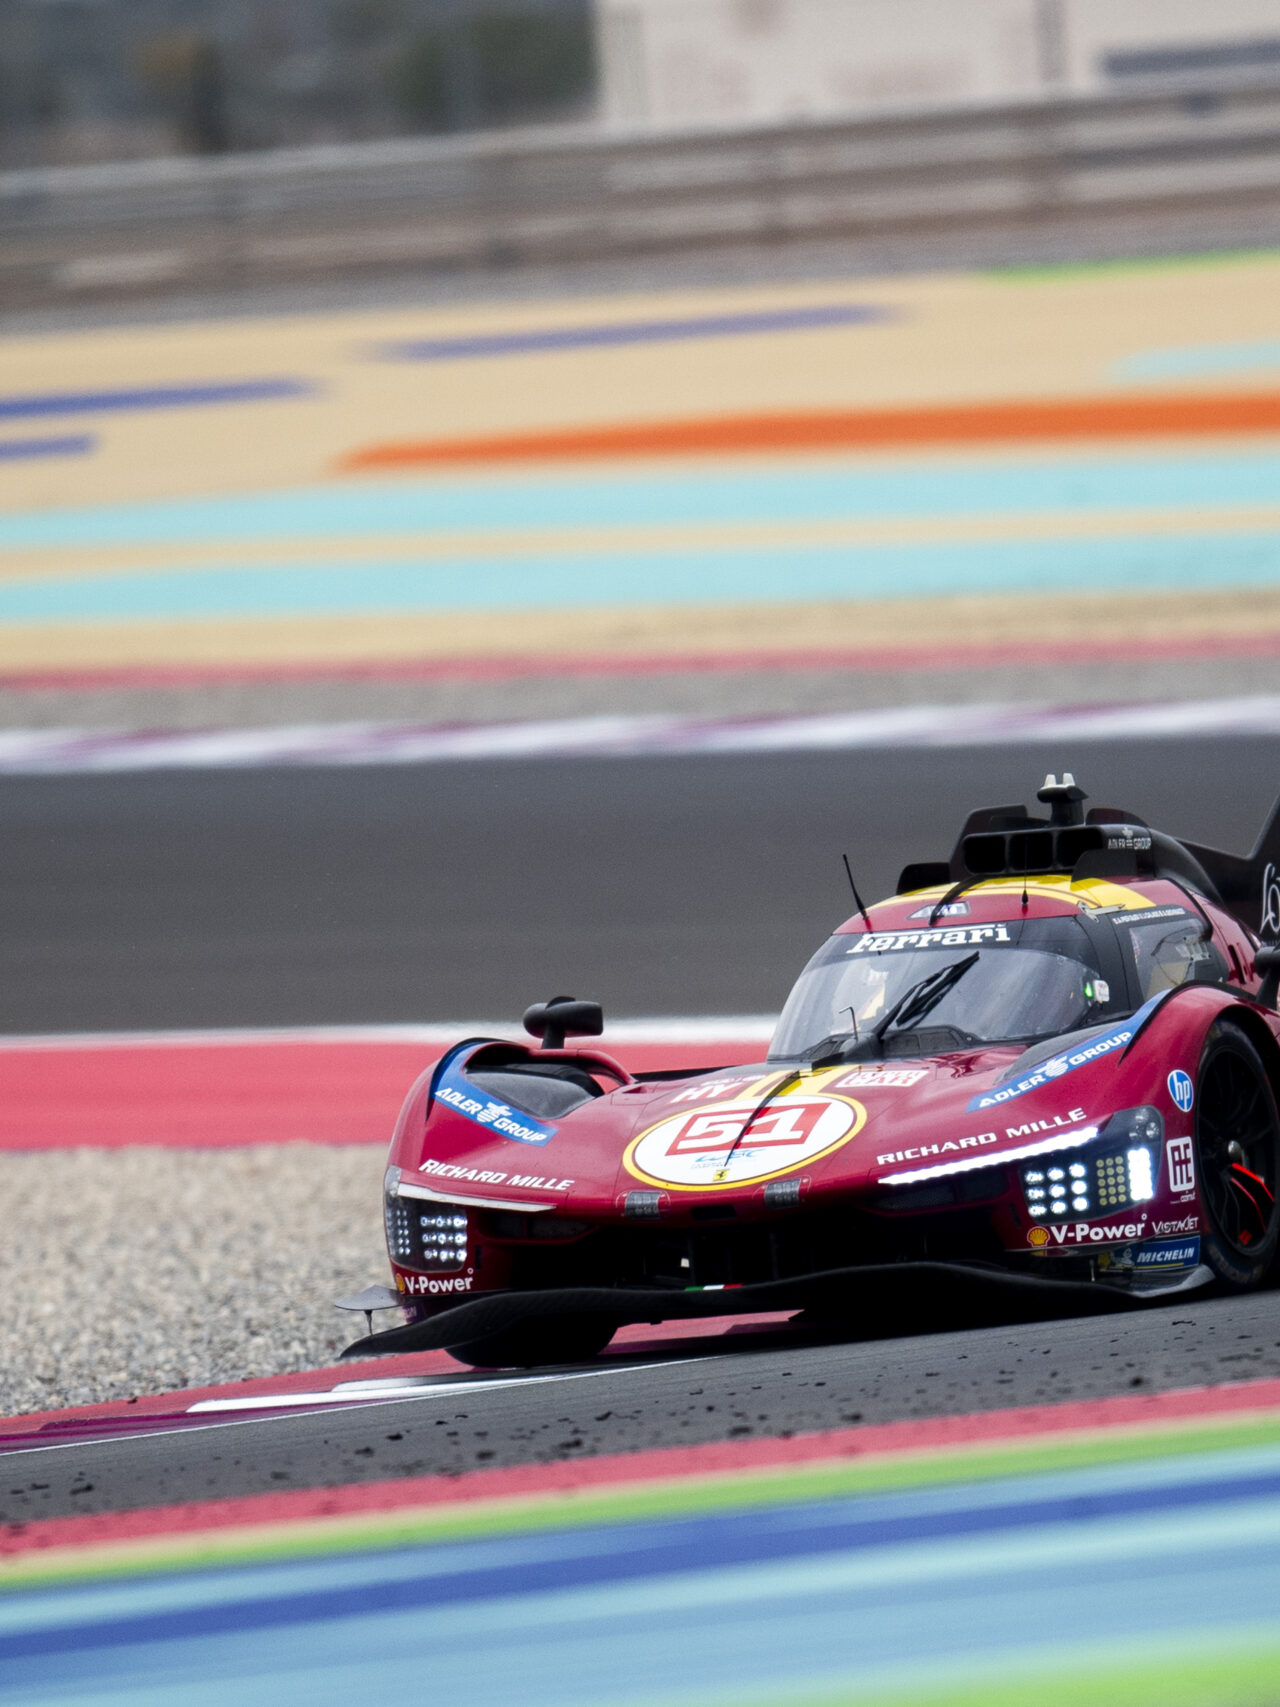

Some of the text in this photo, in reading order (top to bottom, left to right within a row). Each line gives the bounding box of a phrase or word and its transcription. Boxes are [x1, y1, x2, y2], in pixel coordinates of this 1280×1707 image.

[846, 924, 1011, 954] Ferrari
[978, 1031, 1132, 1108] ADLER GROUP
[1173, 1075, 1192, 1111] hp
[434, 1087, 548, 1143] ADLER GROUP
[675, 1106, 807, 1151] 51
[877, 1107, 1088, 1166] RICHARD MILLE
[418, 1158, 576, 1192] RICHARD MILLE
[1050, 1222, 1146, 1244] V-Power
[1136, 1246, 1196, 1263] MICHELIN
[404, 1275, 474, 1295] V-Power
